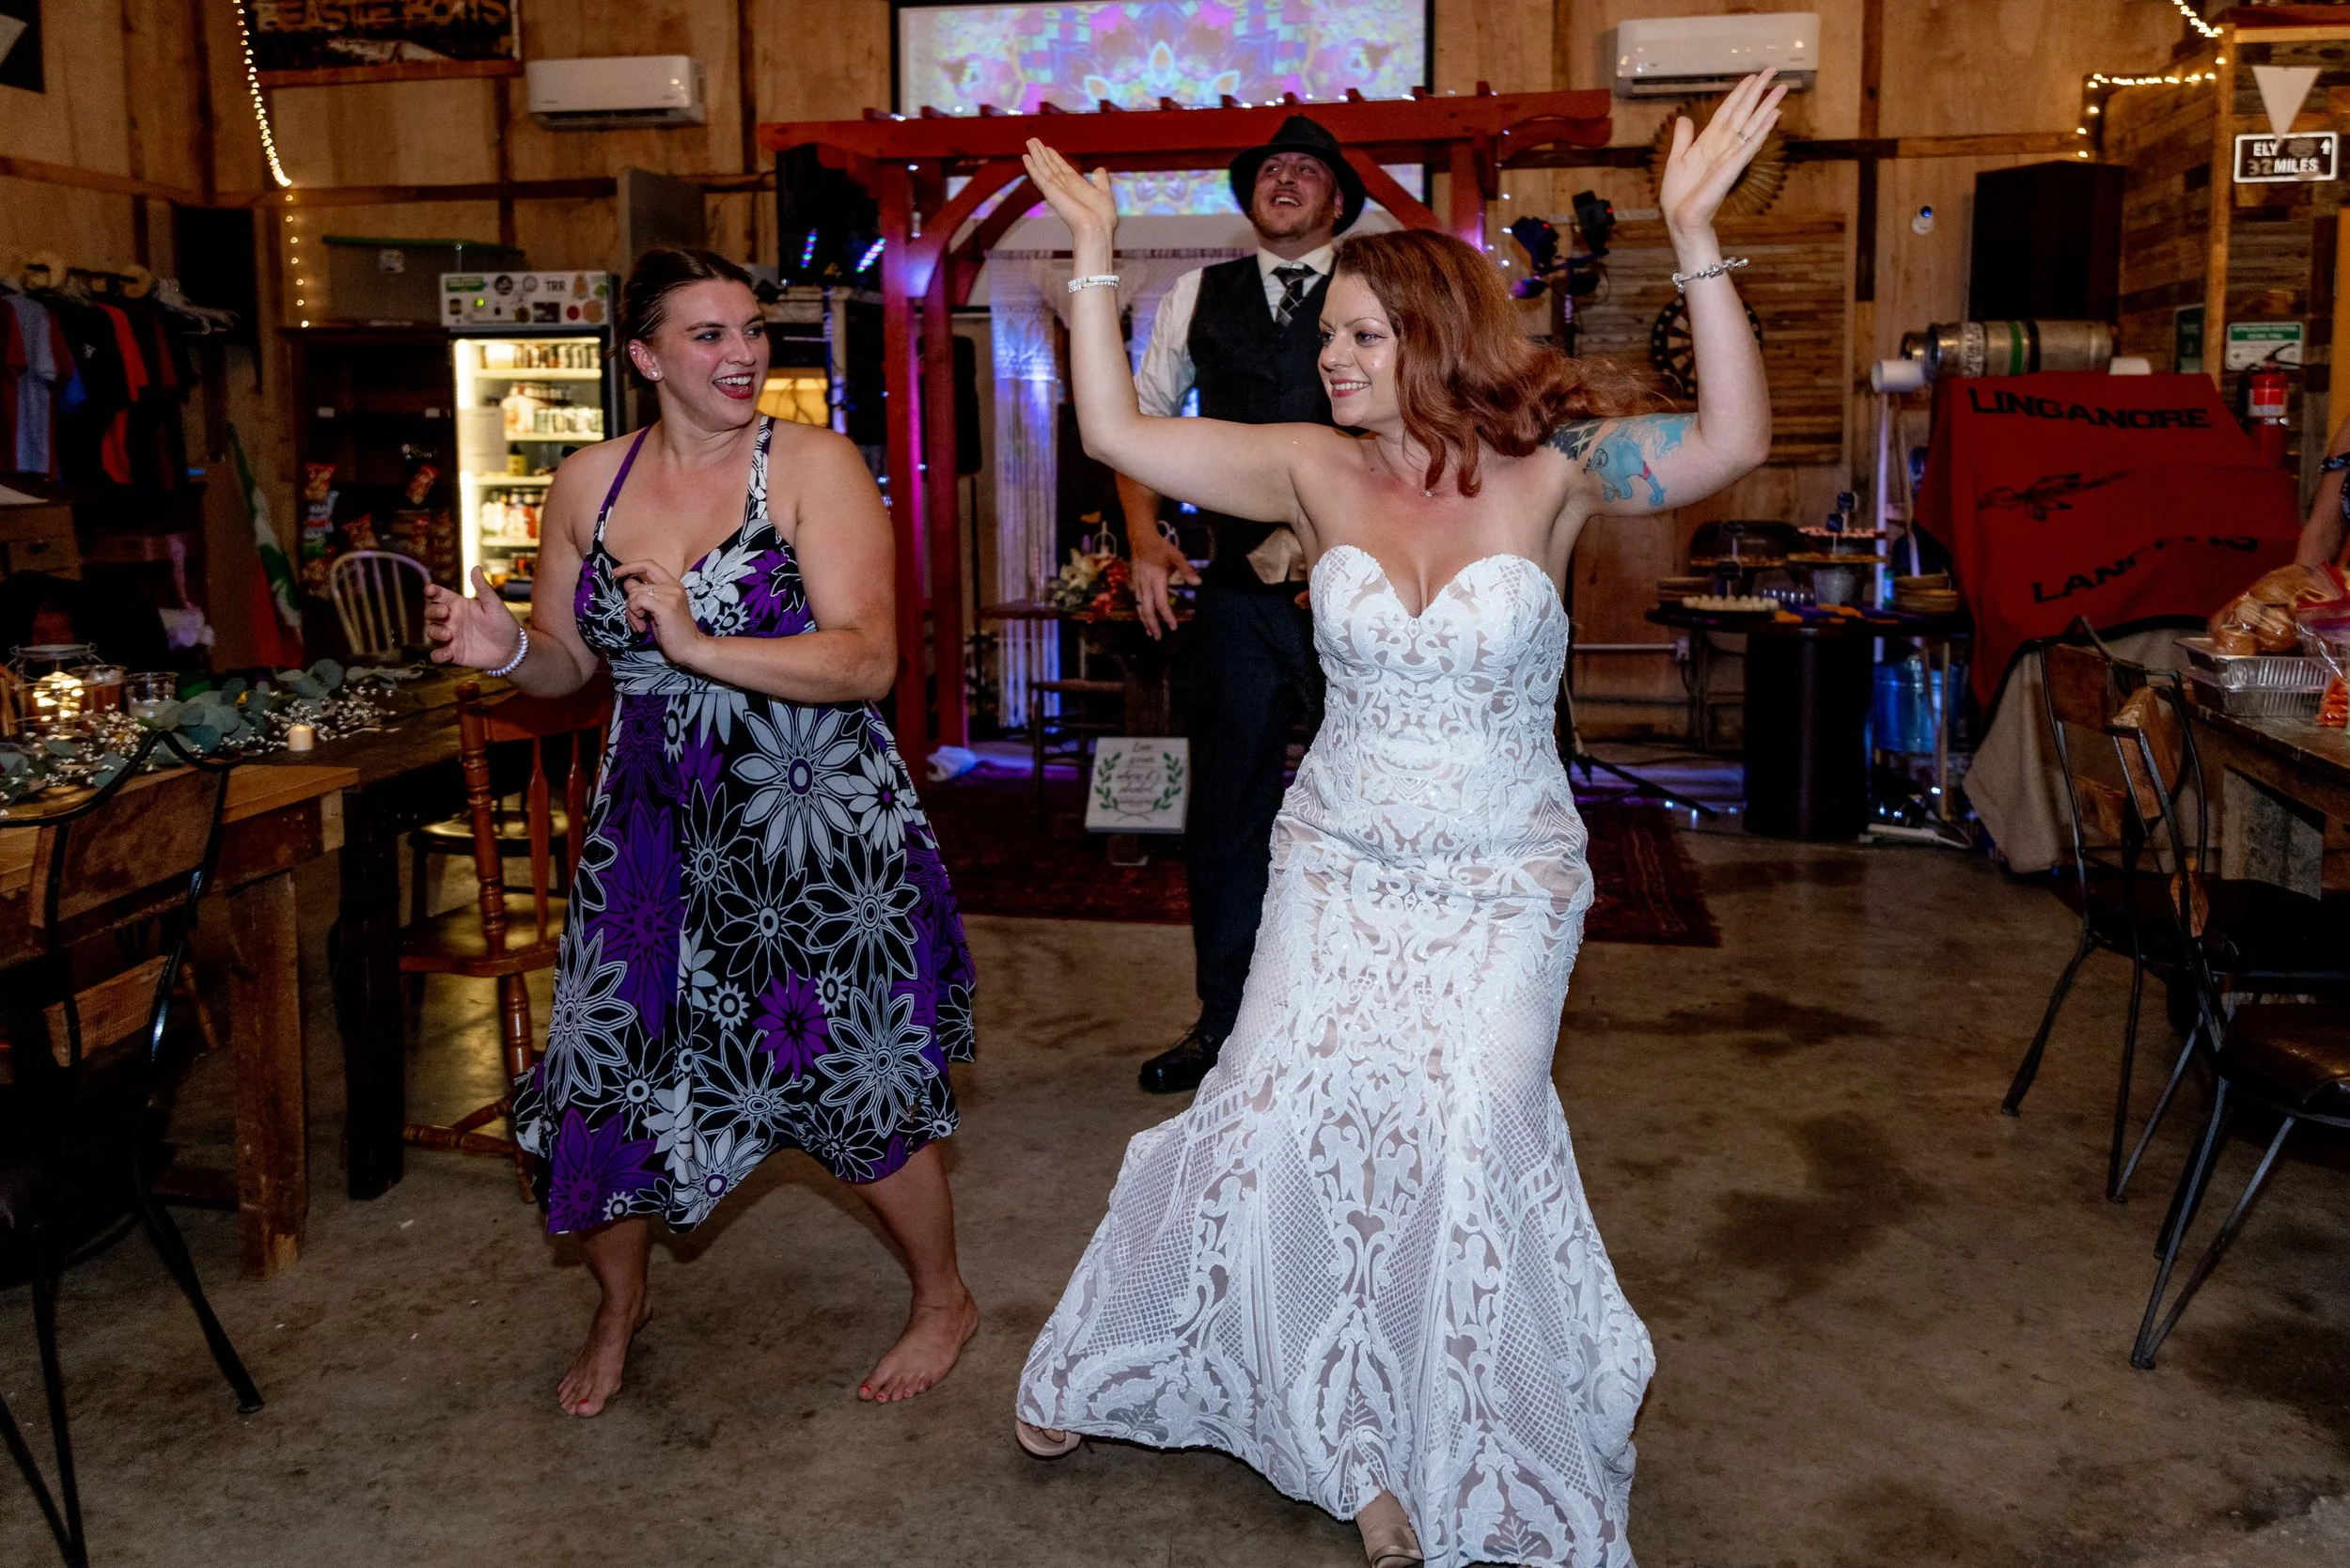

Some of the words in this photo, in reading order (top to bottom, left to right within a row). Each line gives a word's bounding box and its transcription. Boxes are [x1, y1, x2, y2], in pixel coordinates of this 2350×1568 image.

[2253, 141, 2279, 156] ELY
[2274, 157, 2320, 173] MILES
[1967, 387, 2212, 429] LINGANORE
